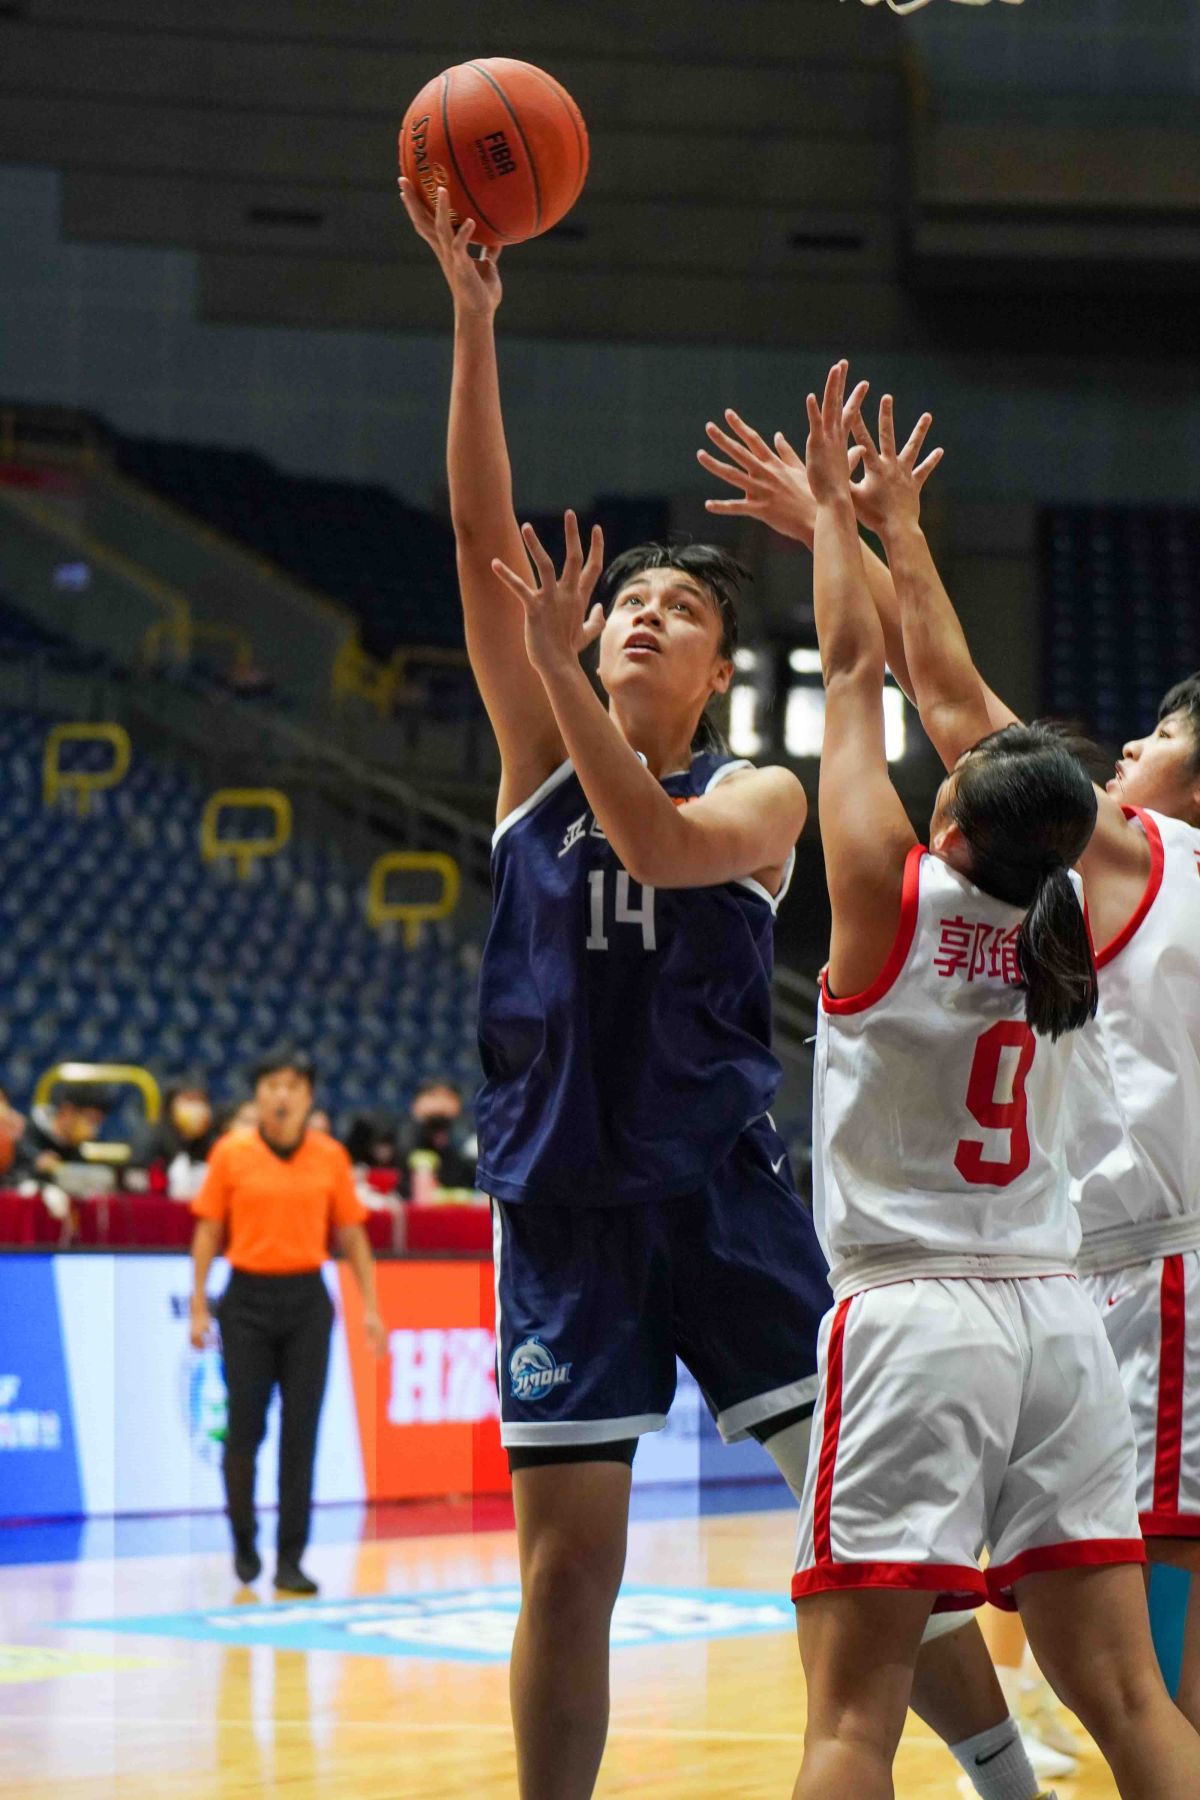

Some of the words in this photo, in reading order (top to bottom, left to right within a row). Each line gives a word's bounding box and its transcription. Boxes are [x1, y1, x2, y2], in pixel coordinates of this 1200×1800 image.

[485, 130, 516, 177] FIBA
[586, 869, 656, 950] 14
[954, 1020, 1036, 1187] 9
